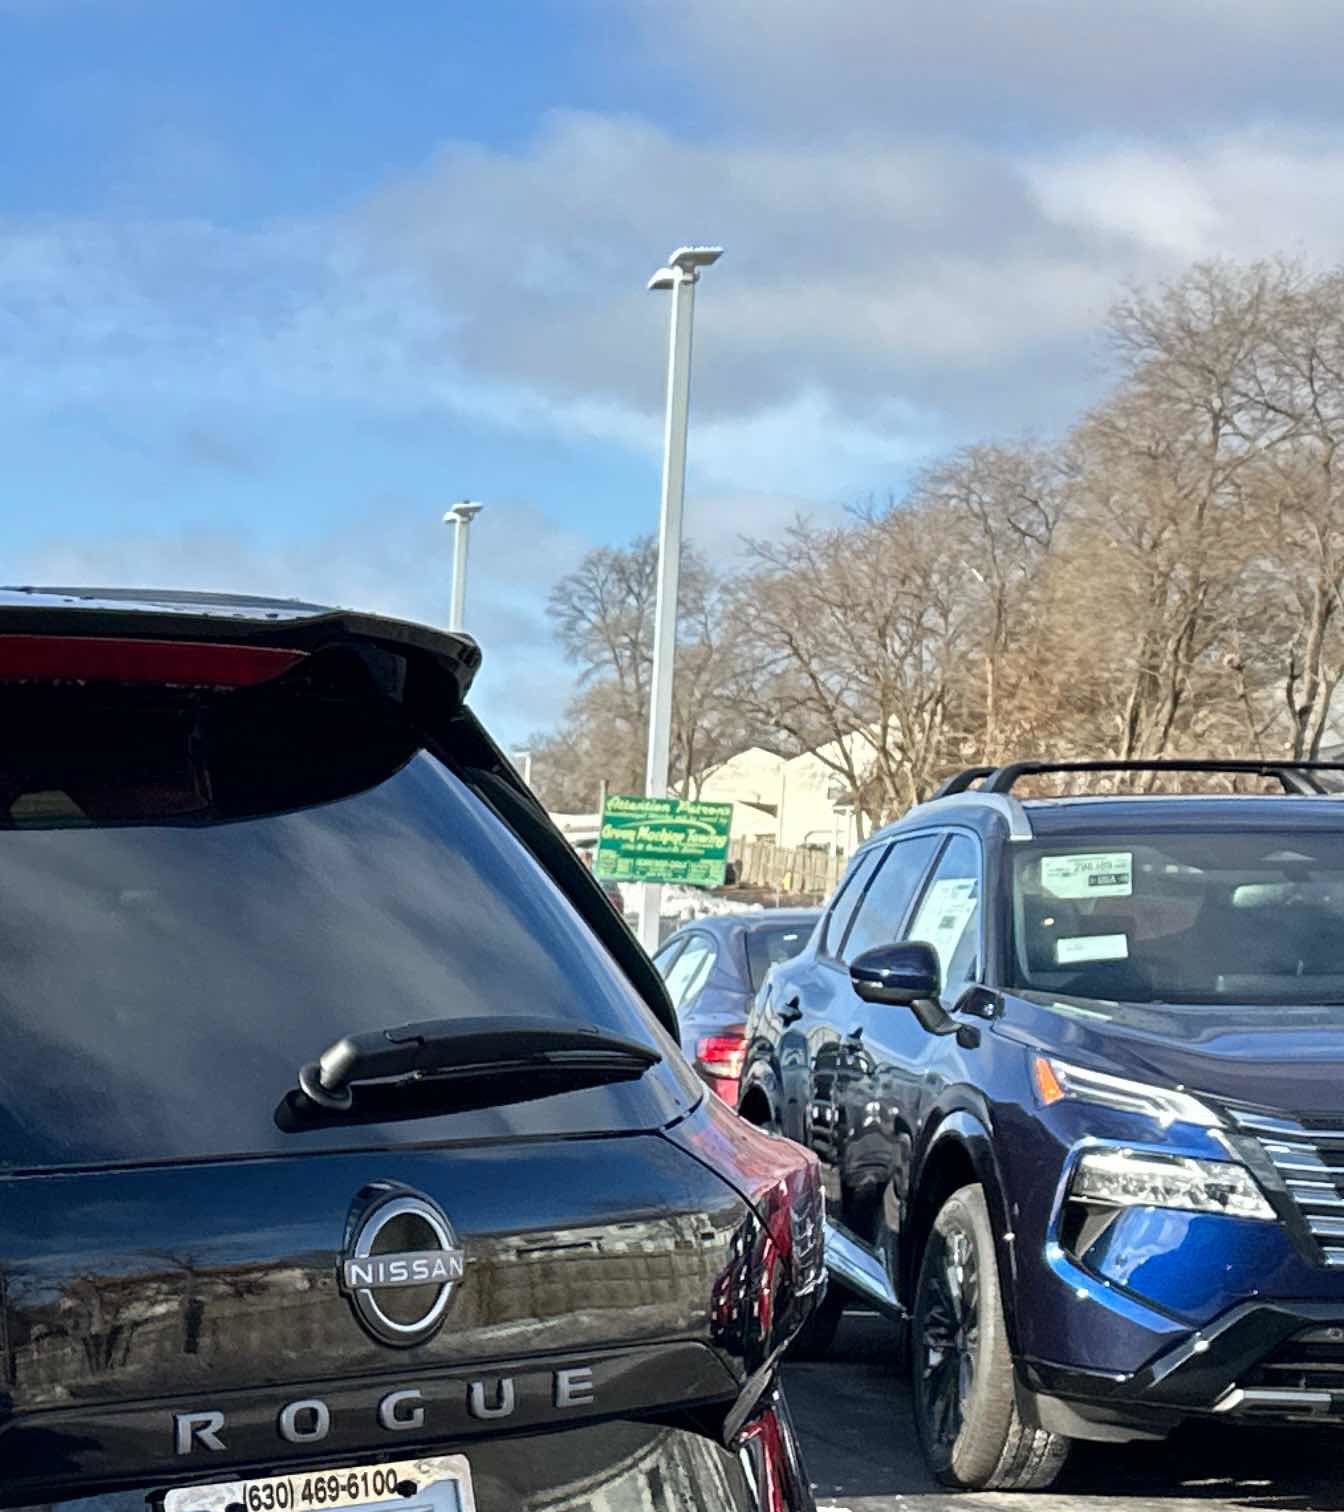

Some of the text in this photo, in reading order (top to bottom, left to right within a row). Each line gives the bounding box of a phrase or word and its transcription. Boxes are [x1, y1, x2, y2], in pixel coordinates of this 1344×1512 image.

[349, 1253, 465, 1287] NISSAN
[174, 1367, 595, 1456] ROGUE
[301, 1468, 399, 1503] 469-6100
